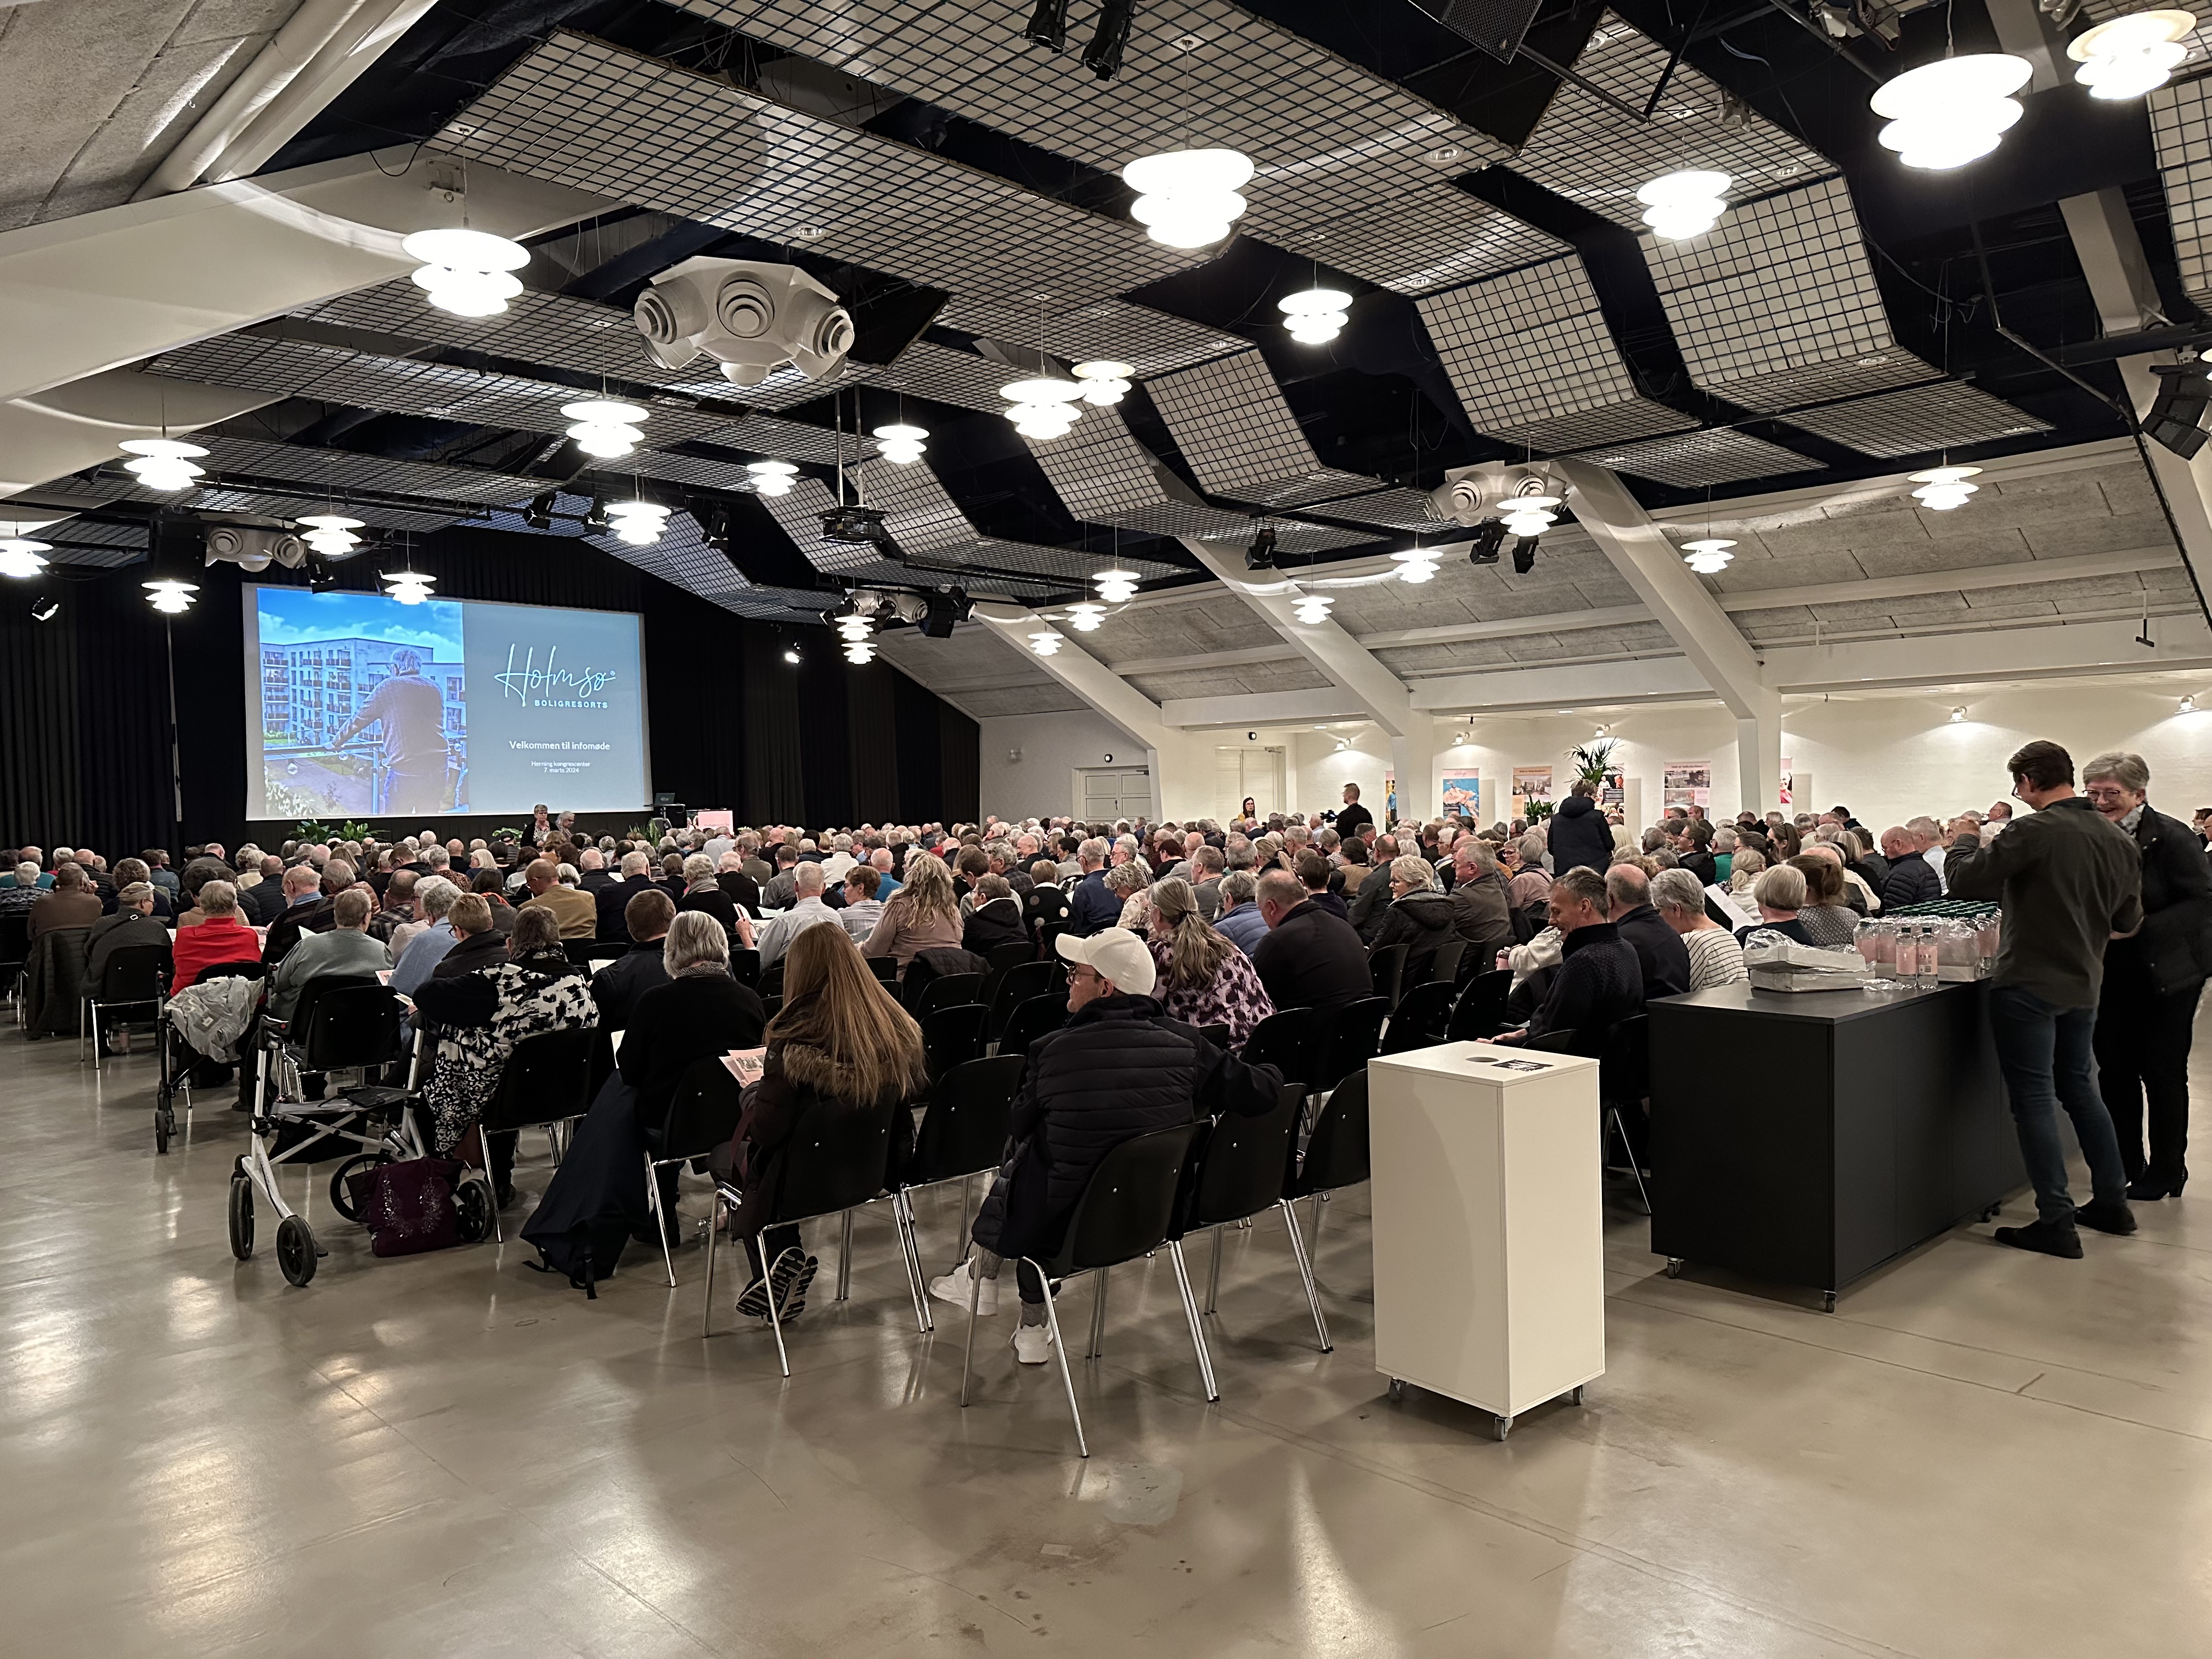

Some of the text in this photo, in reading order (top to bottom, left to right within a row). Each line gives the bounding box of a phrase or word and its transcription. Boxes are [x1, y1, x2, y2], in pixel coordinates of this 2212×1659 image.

[534, 699, 608, 708] BOLIGRESORTS
[509, 741, 611, 751] Velkommen til infomøde
